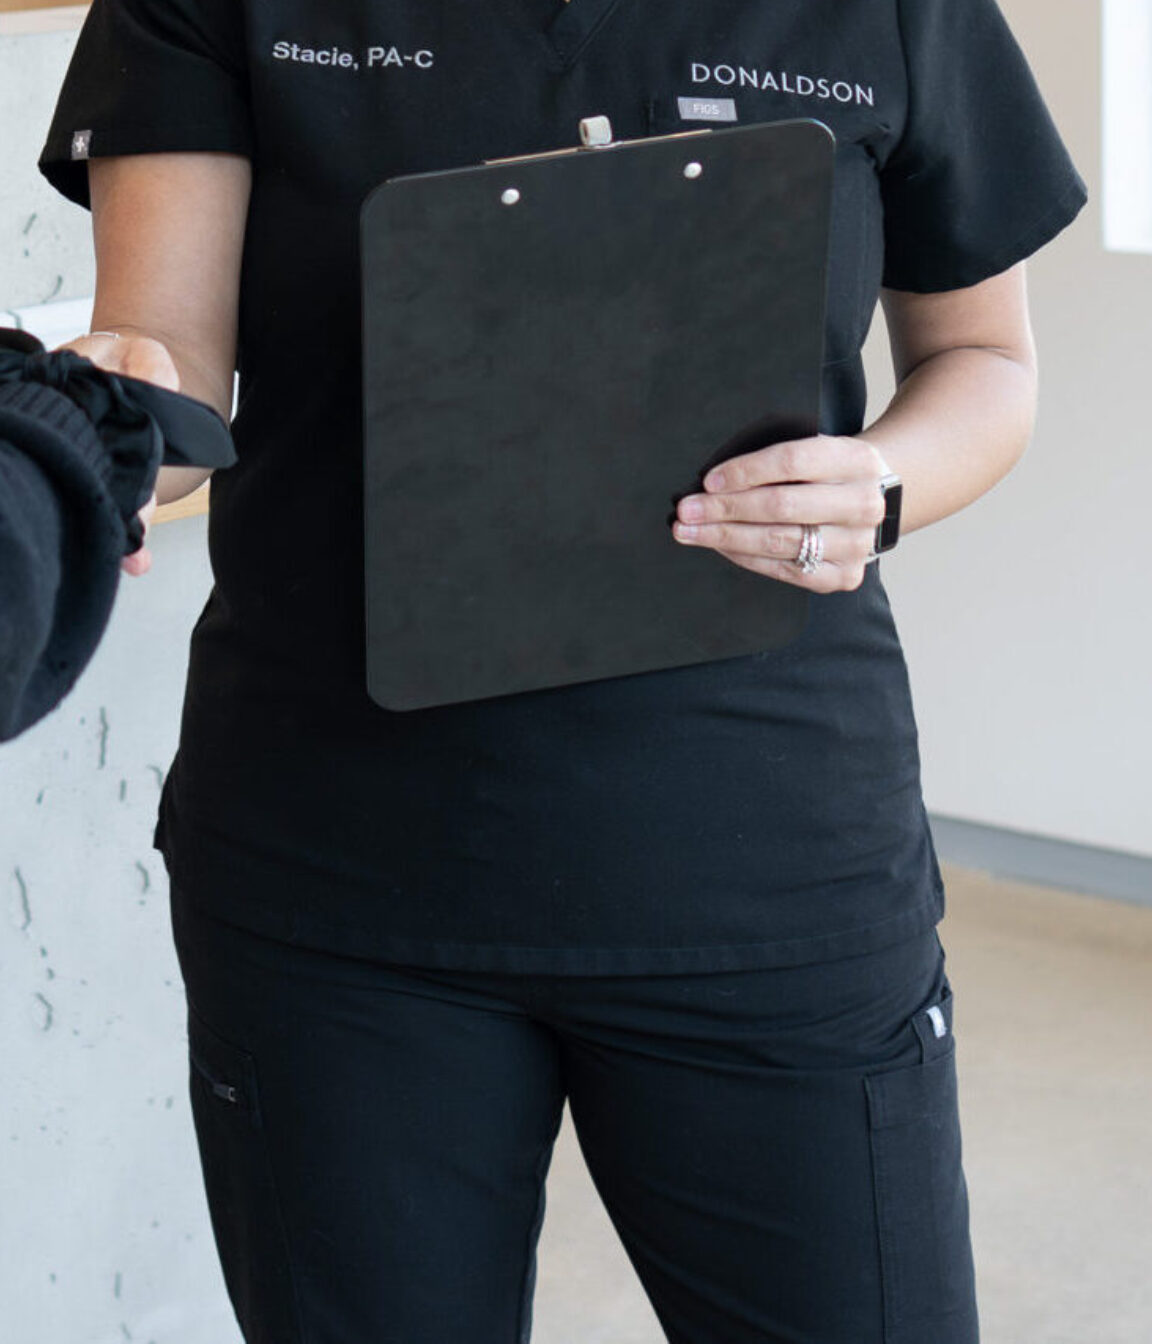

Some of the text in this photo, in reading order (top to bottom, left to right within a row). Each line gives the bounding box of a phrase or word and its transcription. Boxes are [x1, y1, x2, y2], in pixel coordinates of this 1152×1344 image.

[272, 41, 434, 71] Stacie, PA-C
[691, 63, 874, 106] DONALDSON
[693, 103, 720, 115] FIGS
